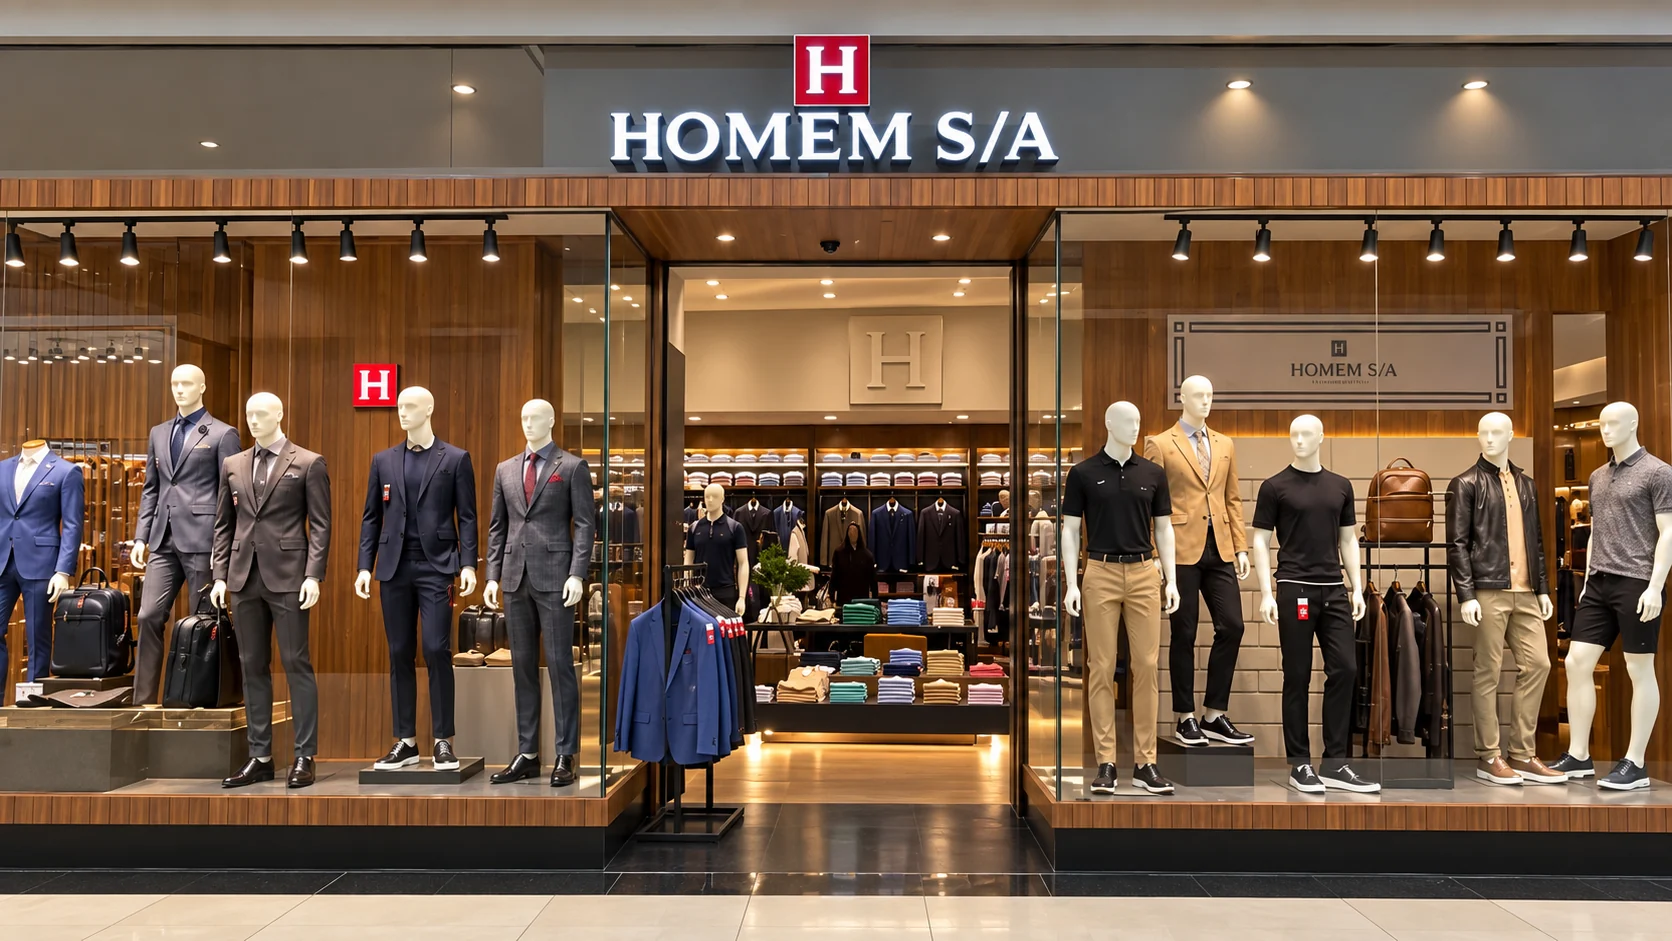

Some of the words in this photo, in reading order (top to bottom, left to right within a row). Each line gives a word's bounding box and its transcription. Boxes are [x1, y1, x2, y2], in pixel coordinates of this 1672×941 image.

[805, 45, 858, 94] H
[610, 111, 912, 162] HOMEM
[936, 110, 1060, 163] S/A
[866, 331, 925, 389] H
[1334, 343, 1344, 354] H
[359, 369, 390, 400] H
[1291, 363, 1362, 377] HOMEM
[1368, 363, 1397, 377] S/A
